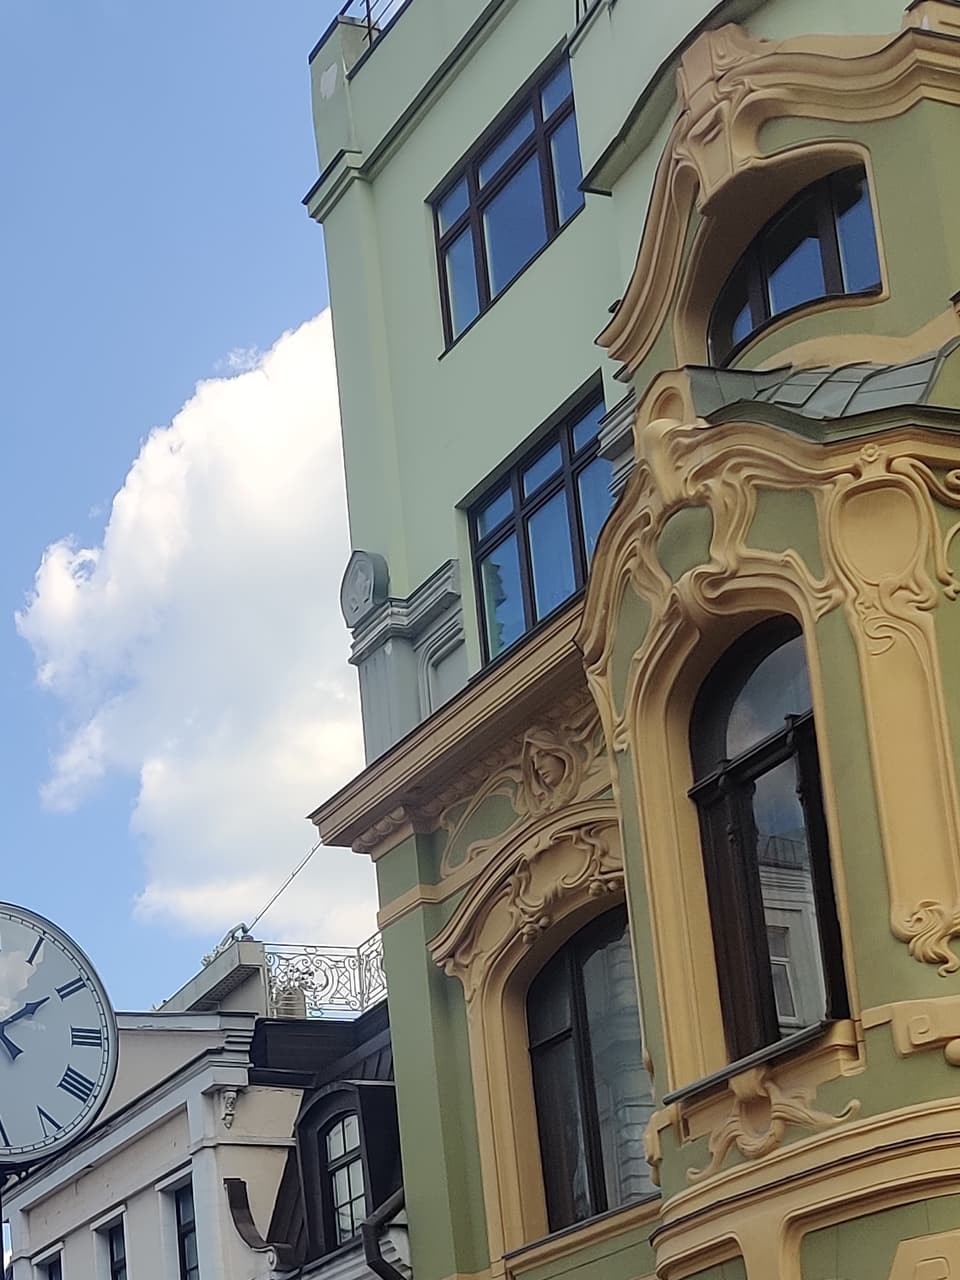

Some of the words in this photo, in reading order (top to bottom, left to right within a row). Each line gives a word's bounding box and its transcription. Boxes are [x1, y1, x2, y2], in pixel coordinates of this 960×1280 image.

[25, 934, 46, 966] I
[55, 976, 88, 1001] II
[70, 1025, 102, 1048] III
[57, 1064, 96, 1105] IIII
[36, 1105, 64, 1138] V
